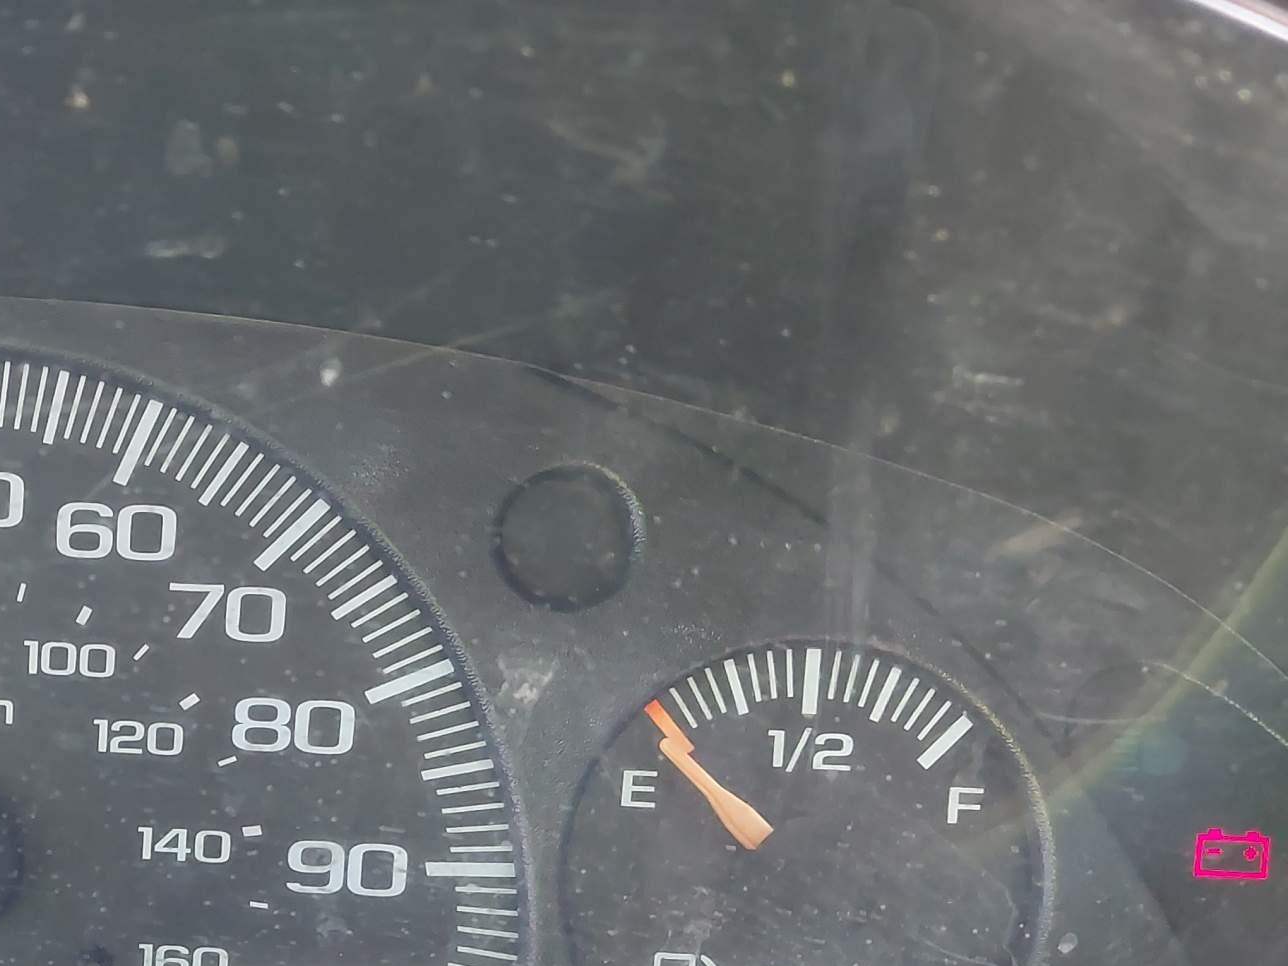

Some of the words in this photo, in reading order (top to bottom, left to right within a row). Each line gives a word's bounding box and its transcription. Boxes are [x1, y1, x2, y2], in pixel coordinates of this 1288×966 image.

[55, 502, 178, 561] 60
[168, 583, 287, 643] 70
[23, 640, 116, 678] 100
[93, 719, 184, 756] 120
[231, 697, 357, 755] 80
[767, 728, 857, 773] 1/2
[620, 769, 658, 809] E
[946, 786, 985, 825] F
[137, 826, 232, 864] 140
[286, 840, 409, 898] 90
